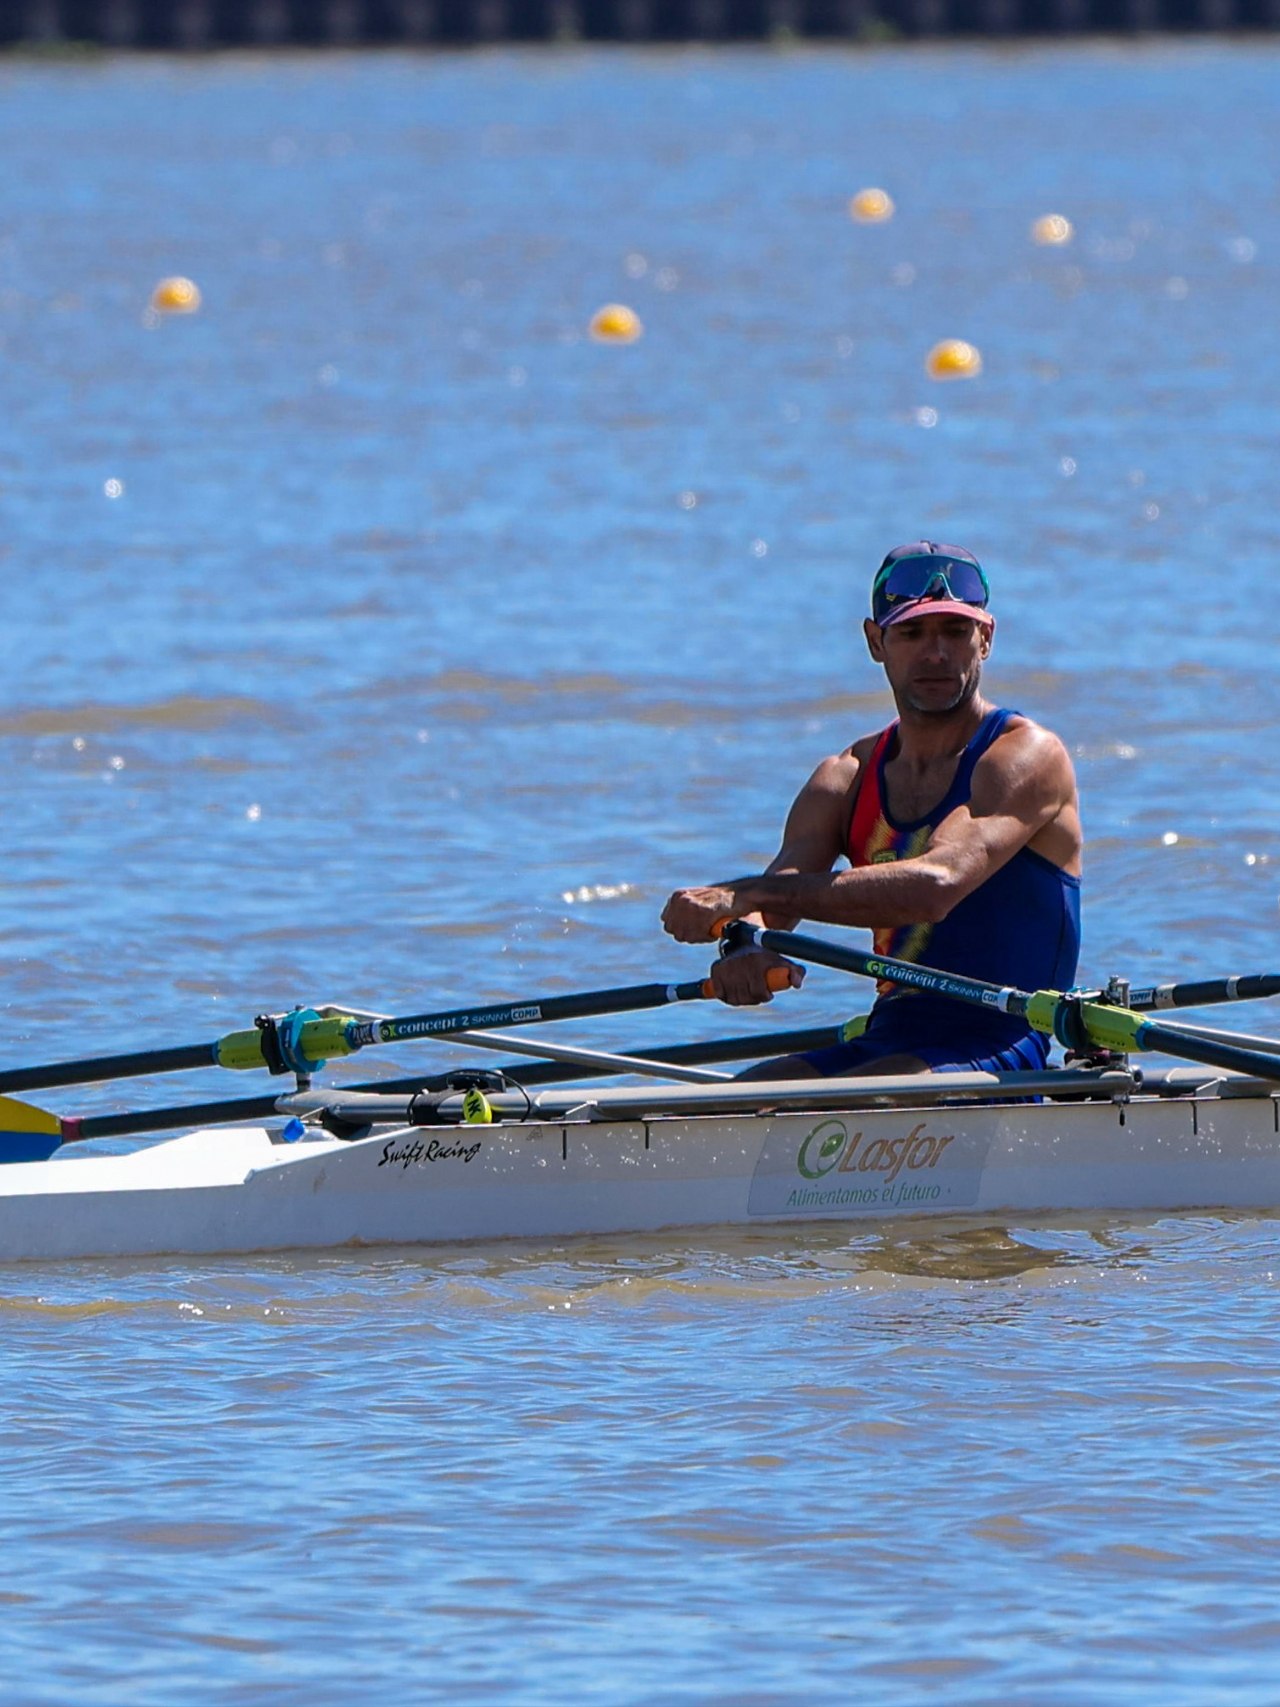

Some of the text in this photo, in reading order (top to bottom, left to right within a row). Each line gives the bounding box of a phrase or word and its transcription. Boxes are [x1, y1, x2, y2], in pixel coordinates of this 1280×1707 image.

[885, 965, 937, 989] concept
[939, 978, 948, 992] 2
[948, 984, 982, 999] SKINNY
[398, 1007, 539, 1036] concept 2 SKINNY COMP
[378, 1140, 482, 1169] Swift Racing
[838, 1123, 955, 1184] Lasfor
[786, 1182, 942, 1207] Alimentamos el futuro
